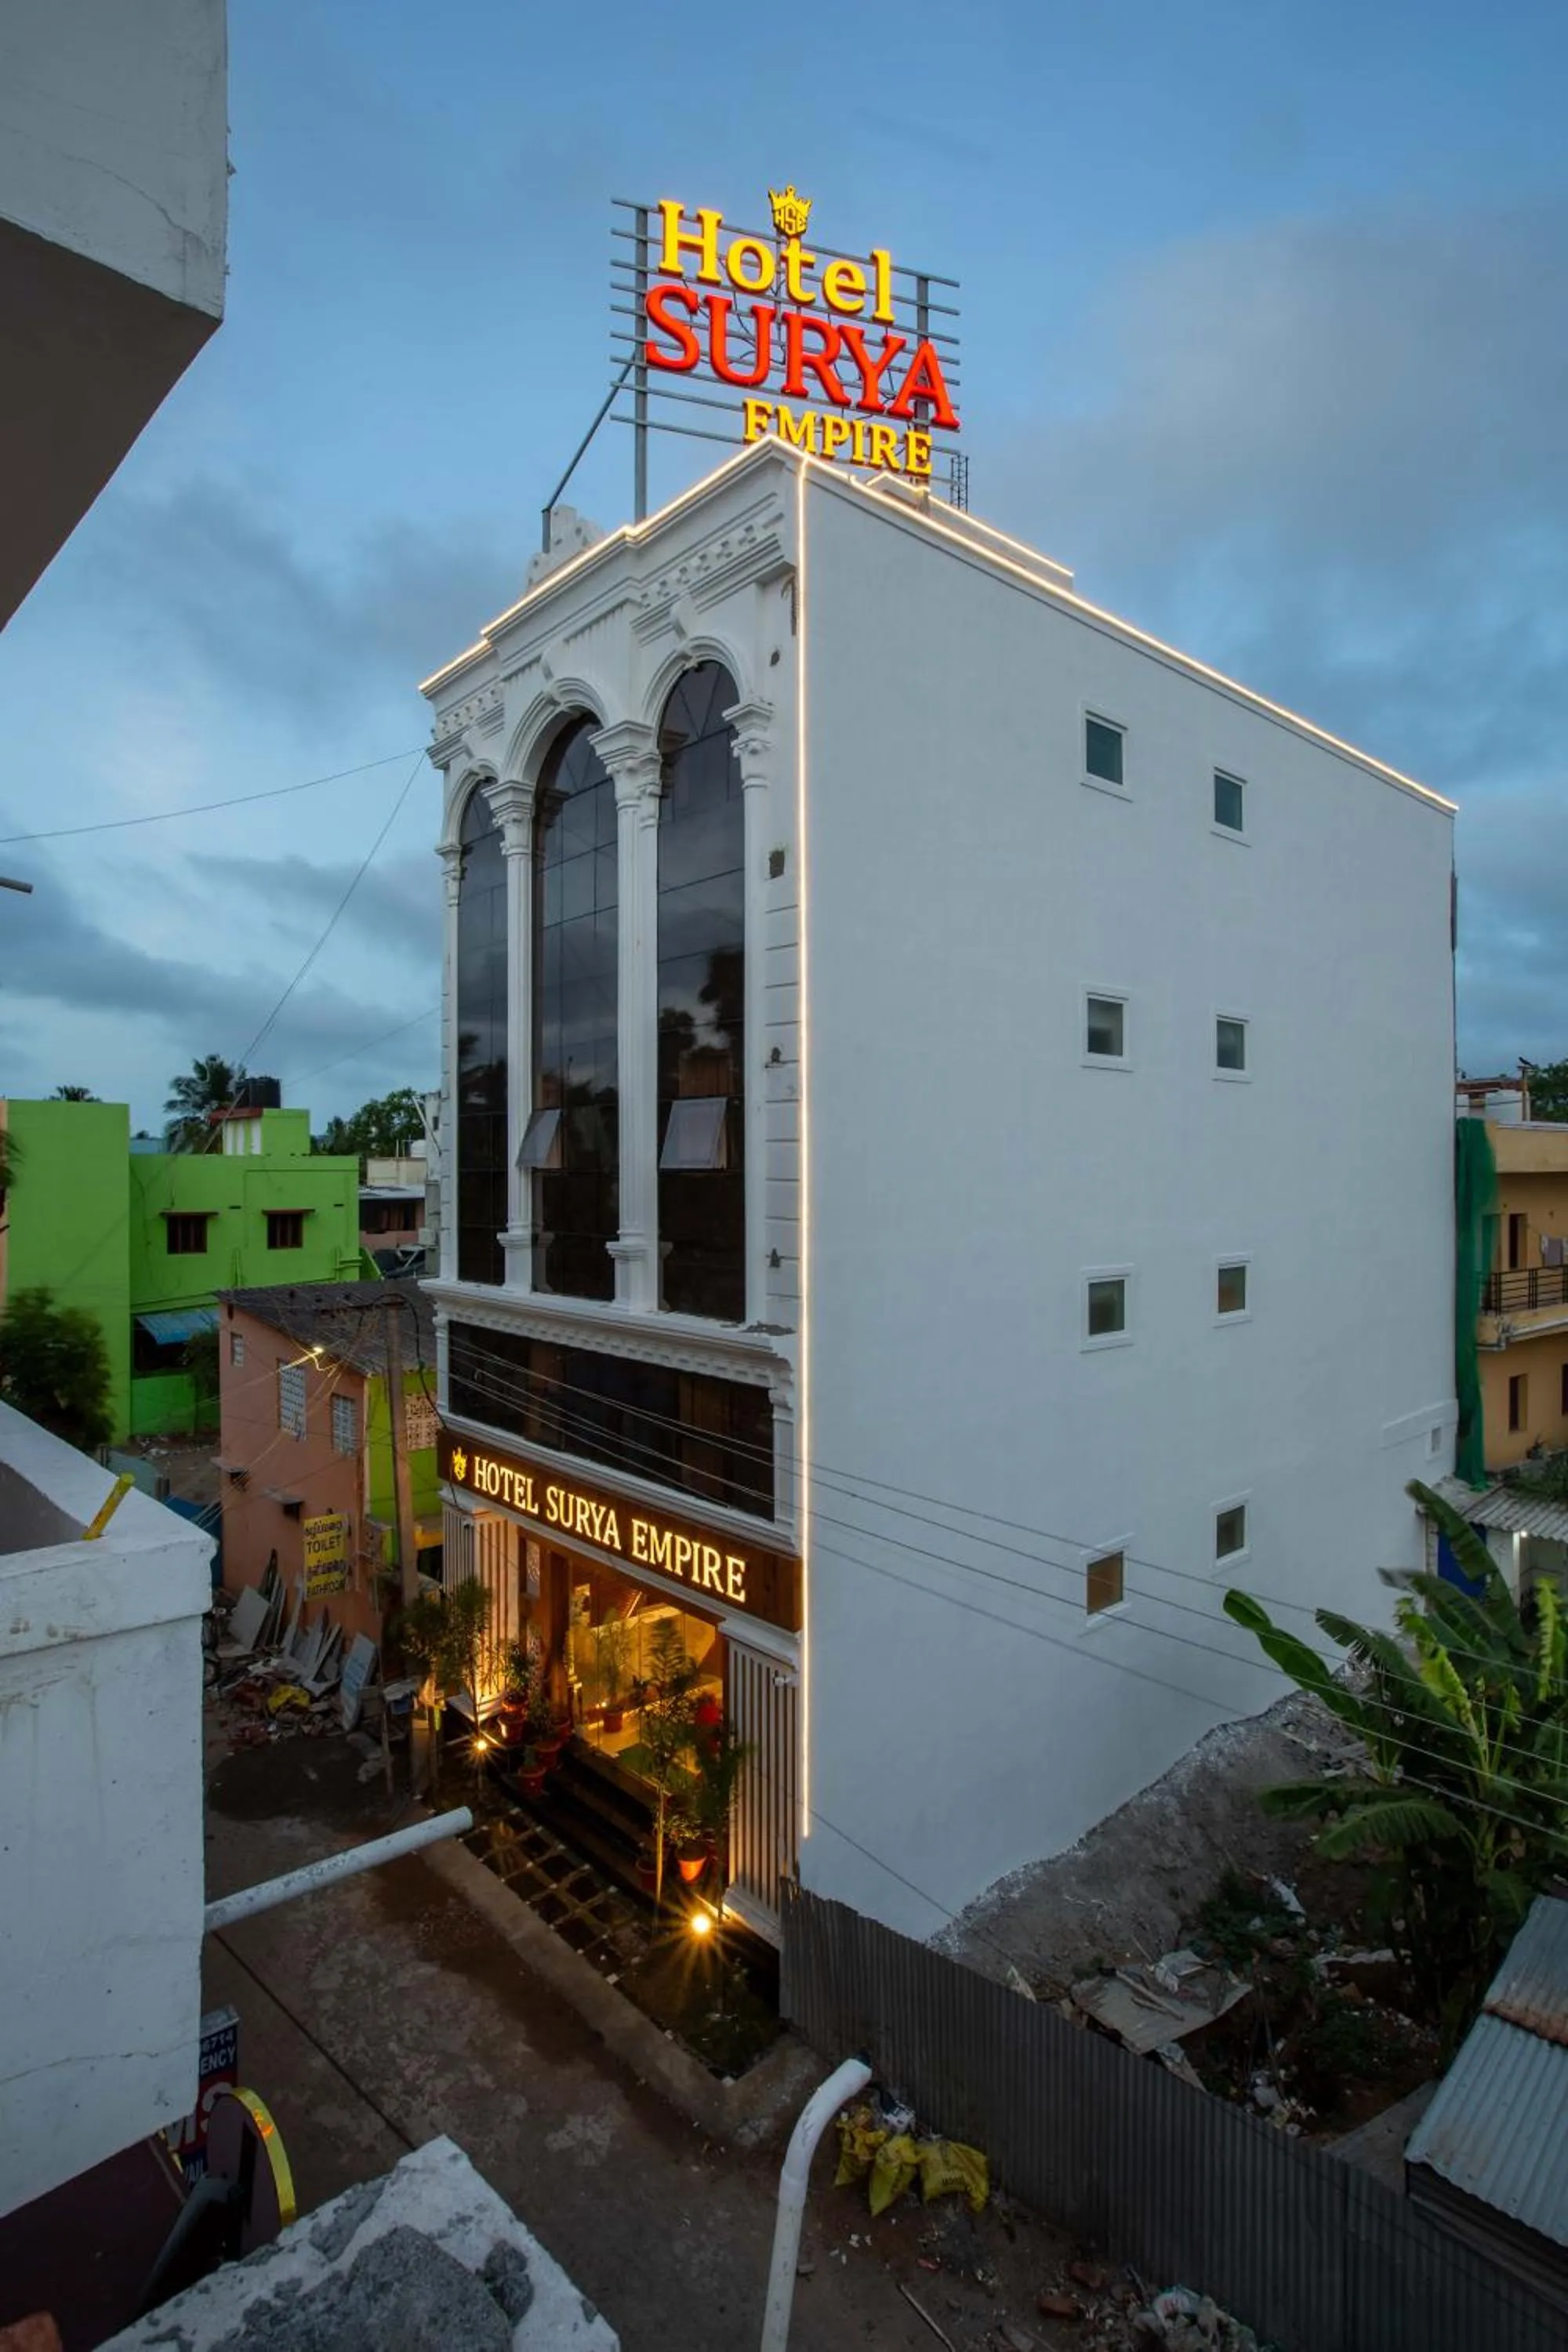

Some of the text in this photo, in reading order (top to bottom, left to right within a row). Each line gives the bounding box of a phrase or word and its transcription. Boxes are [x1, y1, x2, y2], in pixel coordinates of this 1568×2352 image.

[775, 205, 807, 235] HSE
[658, 199, 895, 325] Hotel
[644, 284, 960, 430] SURYA
[742, 397, 934, 476] EMPIRE
[307, 1535, 341, 1554] TOILET
[474, 1455, 746, 1604] HOTEL SURYA EMPIRE
[200, 2044, 236, 2076] ENCY
